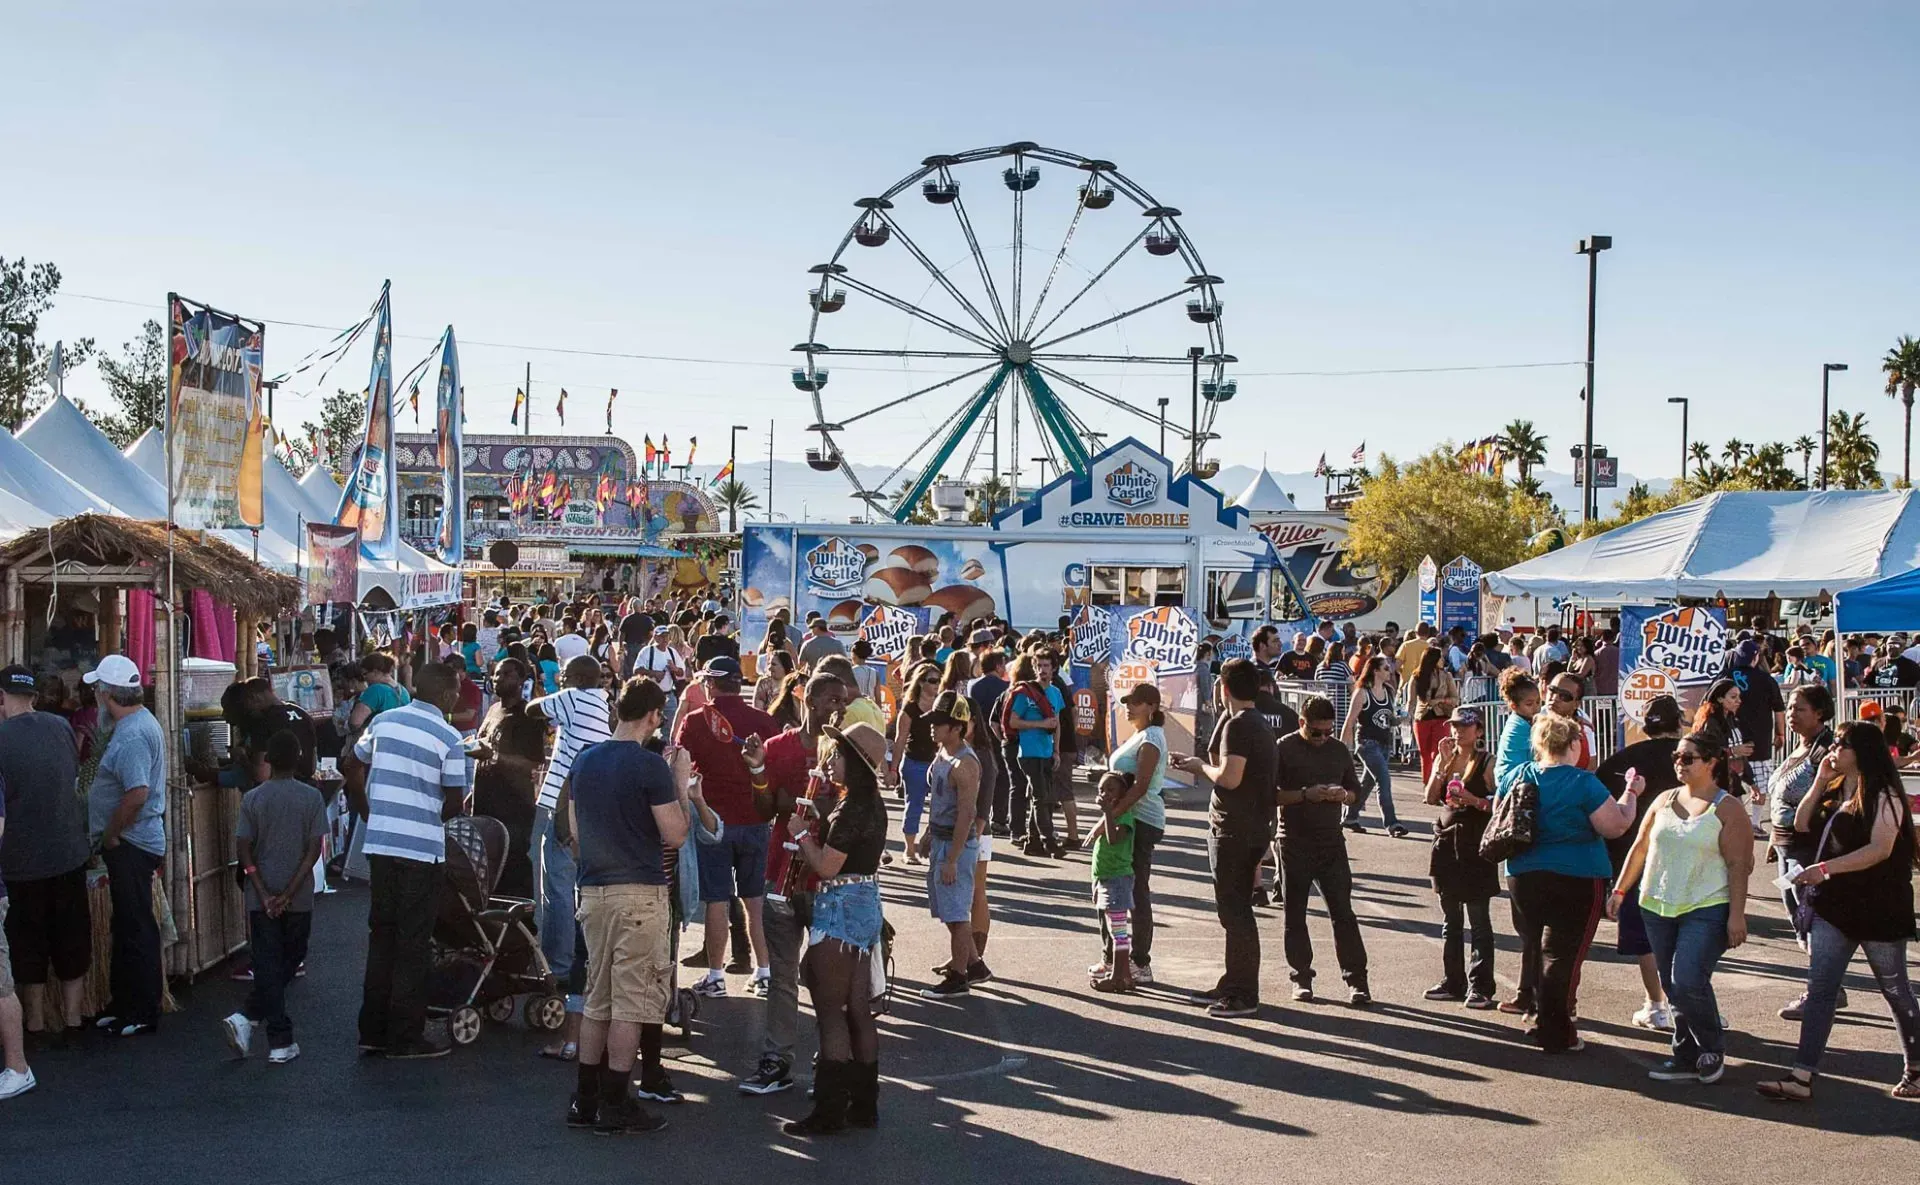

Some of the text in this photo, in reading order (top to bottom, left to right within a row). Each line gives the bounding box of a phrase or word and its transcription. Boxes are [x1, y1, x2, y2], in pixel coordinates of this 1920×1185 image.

[396, 444, 492, 471] MADI
[502, 446, 594, 471] GRAS
[1112, 474, 1151, 490] White
[1108, 486, 1153, 500] Castle
[1060, 511, 1190, 528] #CRAVEMOBILE
[1250, 524, 1327, 543] Miller
[815, 552, 858, 569] White
[811, 566, 859, 581] Castle
[1448, 566, 1478, 579] White
[1445, 577, 1479, 588] Castle
[865, 620, 910, 642] White
[1074, 620, 1108, 645] White
[1139, 619, 1193, 649] White
[1653, 622, 1722, 655] White
[869, 634, 908, 657] astl
[1073, 636, 1111, 661] Castle
[1130, 638, 1193, 667] Castle
[1645, 643, 1720, 677] Castle
[1119, 665, 1147, 679] 30
[1630, 673, 1666, 690] 30
[1078, 694, 1091, 706] 10
[1079, 708, 1096, 717] ACK
